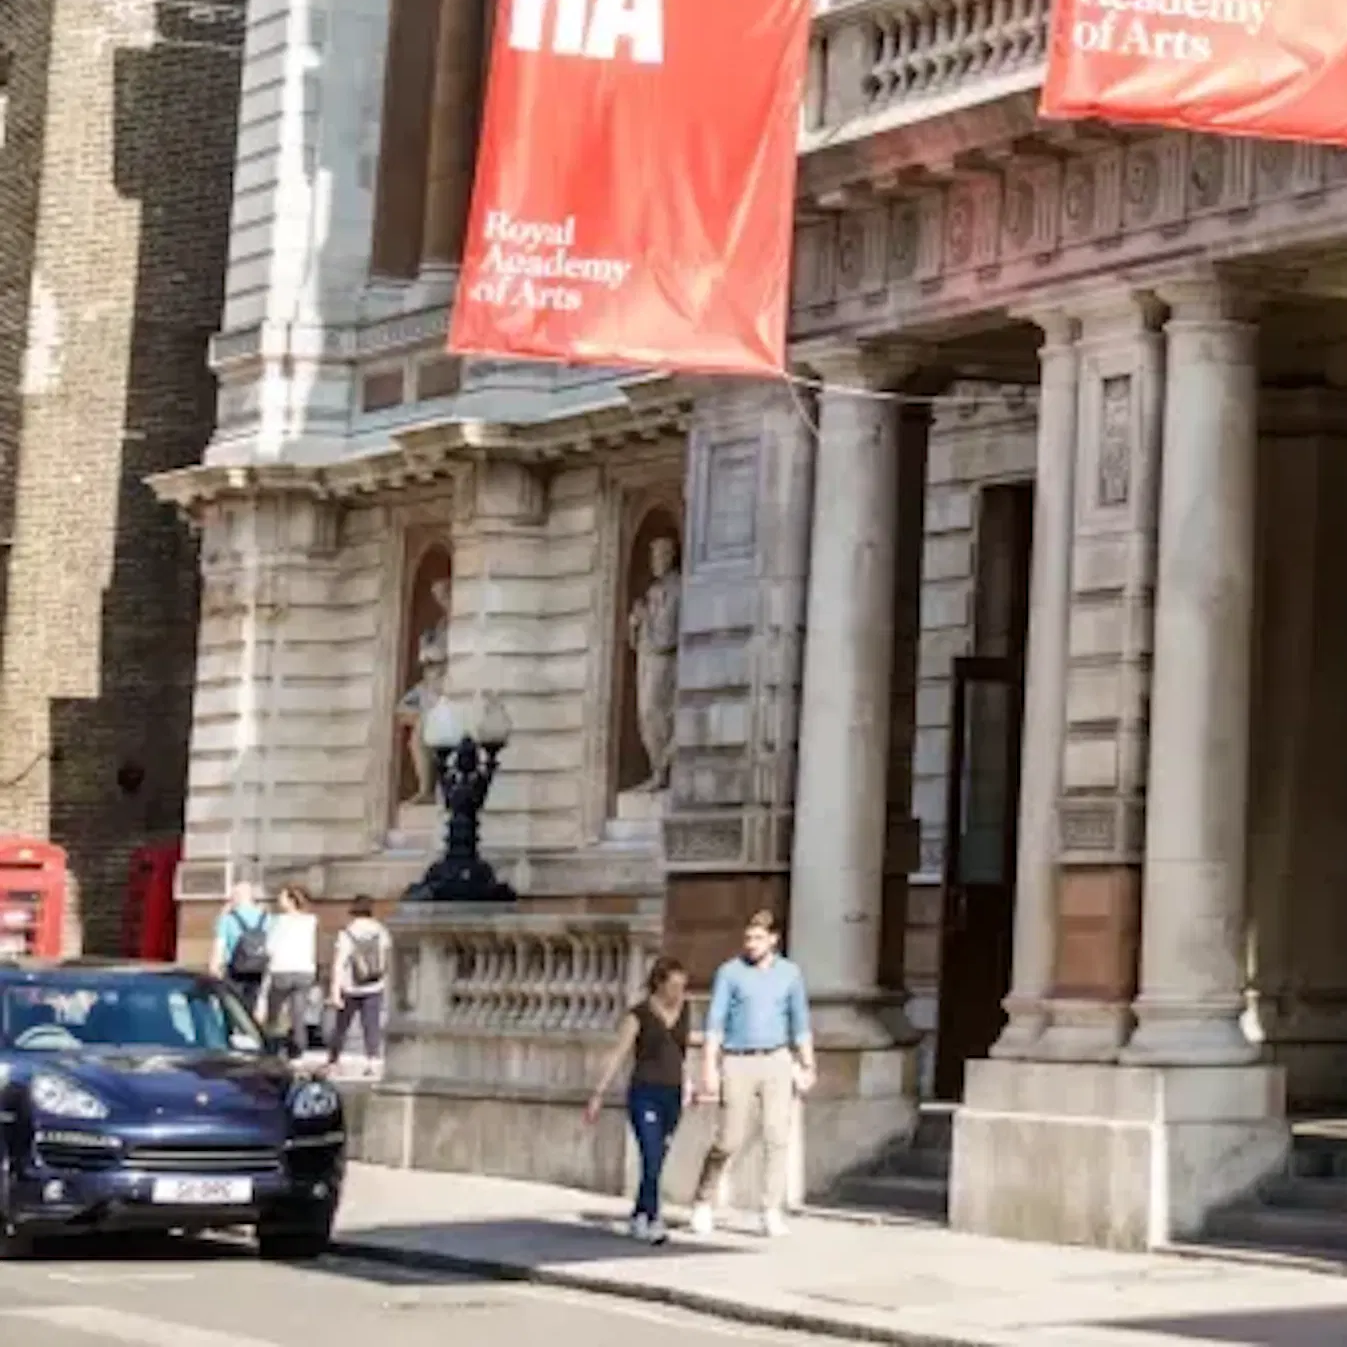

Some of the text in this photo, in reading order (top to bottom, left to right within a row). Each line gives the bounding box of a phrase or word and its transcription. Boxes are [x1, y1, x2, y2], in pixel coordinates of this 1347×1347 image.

[1073, 8, 1213, 62] of Arts
[484, 209, 576, 253] Royal
[480, 243, 633, 292] Academy
[469, 275, 584, 312] of Arts
